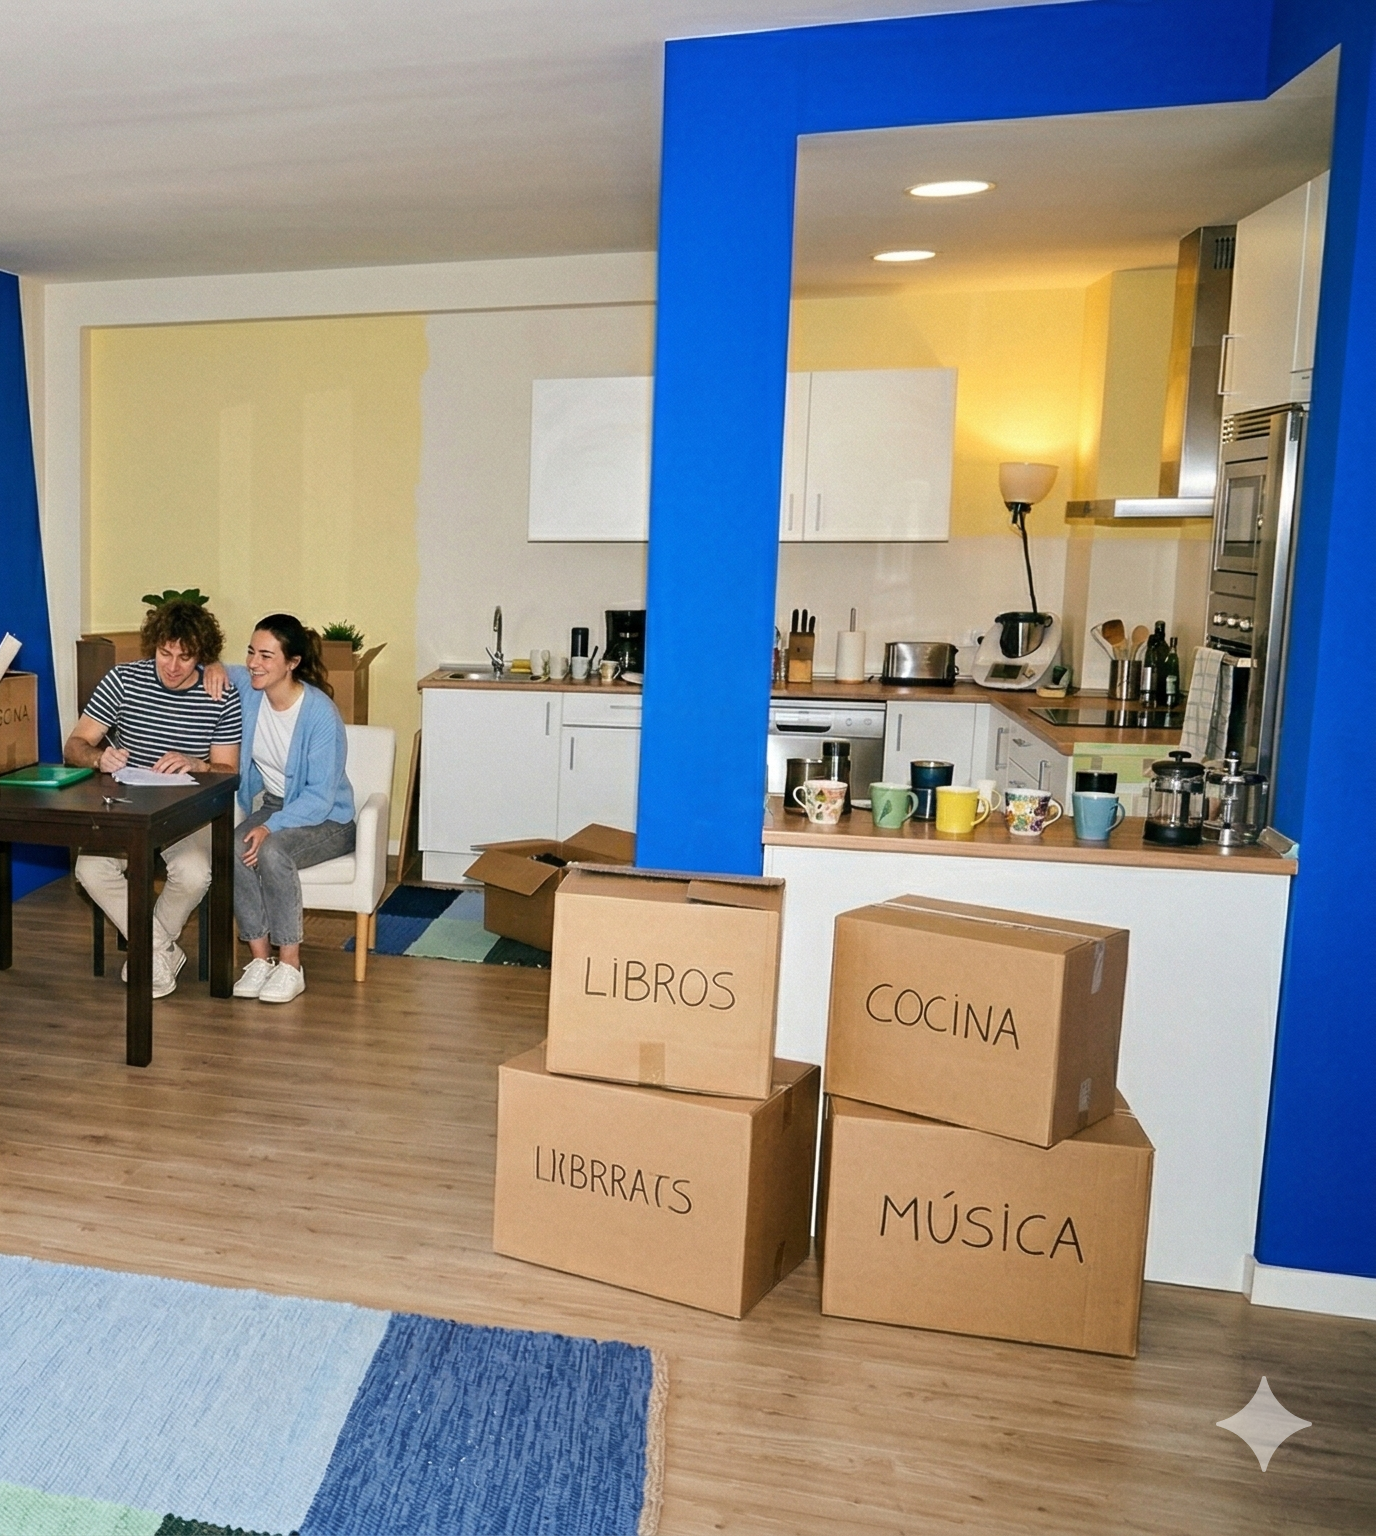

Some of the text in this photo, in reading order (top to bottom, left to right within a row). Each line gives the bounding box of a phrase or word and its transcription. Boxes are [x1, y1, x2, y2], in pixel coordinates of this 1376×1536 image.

[584, 956, 736, 1011] LIBROS
[865, 983, 1020, 1050] COCINA
[880, 1191, 1084, 1263] MÚSICA
